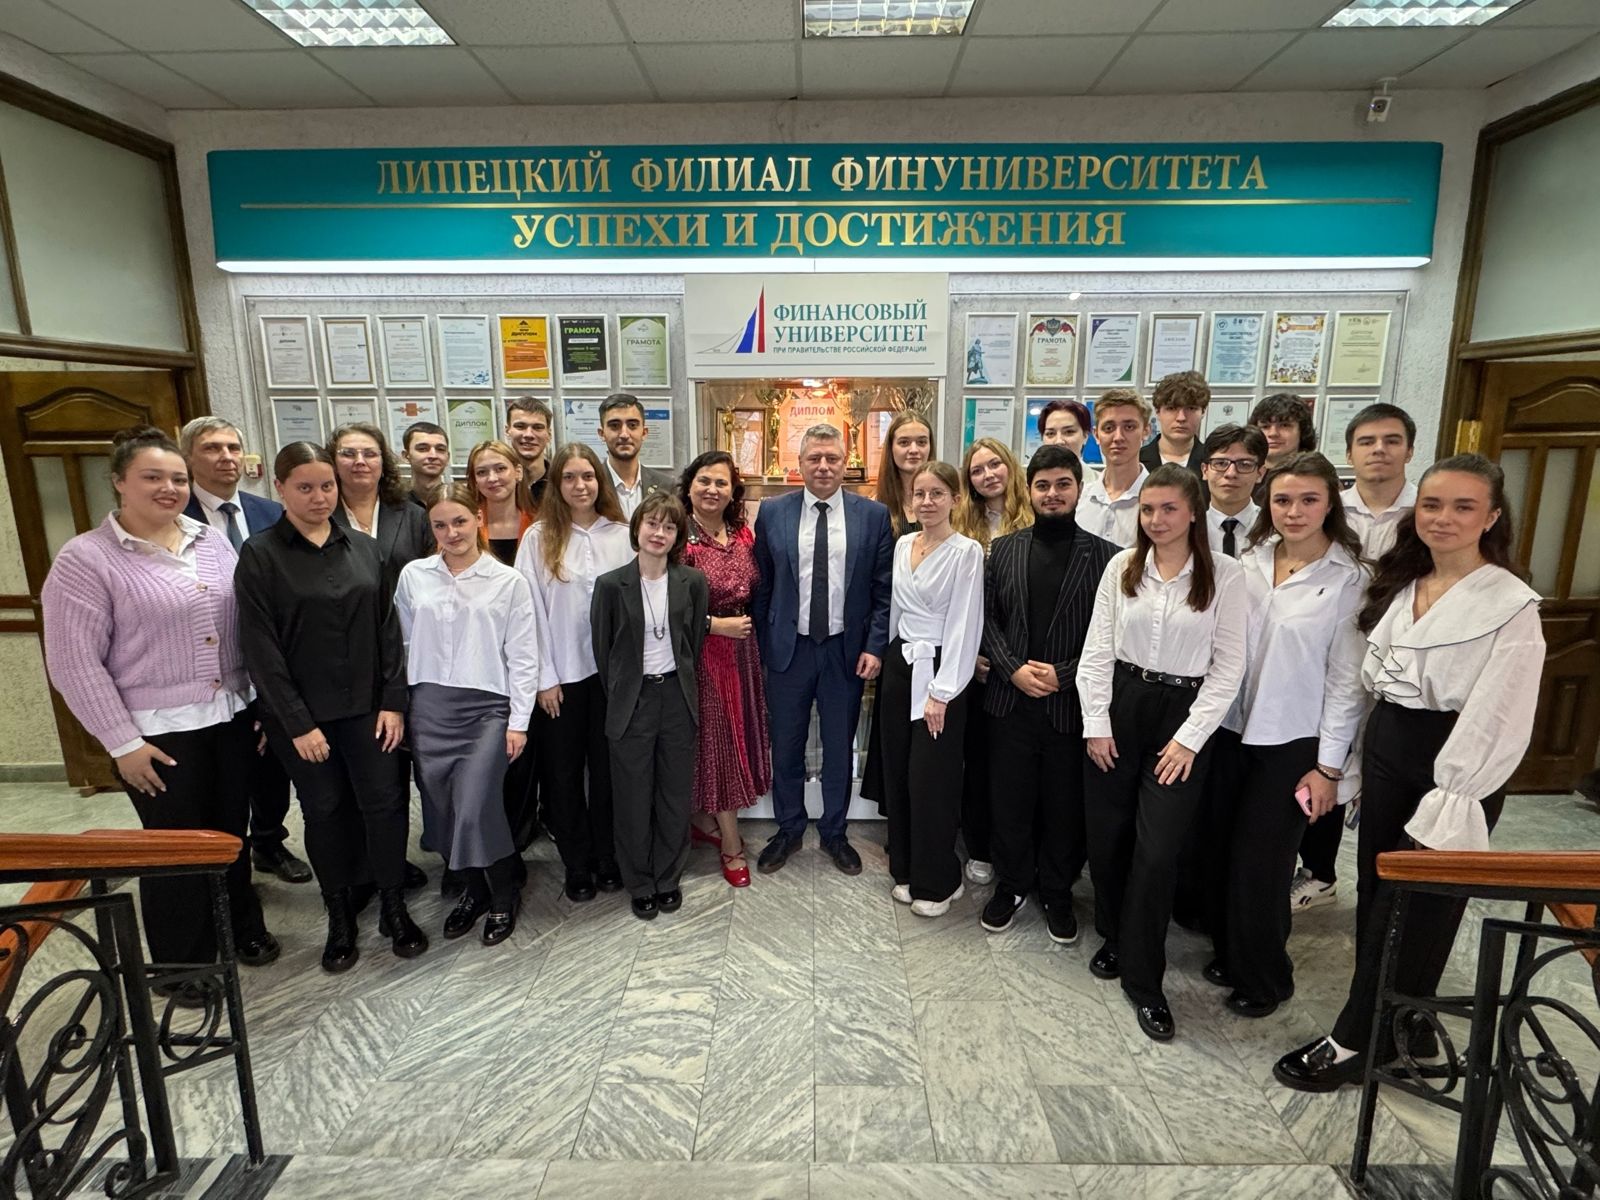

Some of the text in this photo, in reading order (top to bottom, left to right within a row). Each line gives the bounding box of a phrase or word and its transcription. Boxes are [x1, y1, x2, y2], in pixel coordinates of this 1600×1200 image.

[377, 150, 1269, 201] ЛИПЕЦКИЙ ФИЛИАЛ ФИНУНИВЕРСИТЕТА
[512, 211, 1126, 256] УСПЕХИ И ДОСТИЖЕНИЯ
[773, 298, 928, 321] ФИНАНСОВЫЙ
[563, 326, 602, 335] ГРАМОТА
[773, 324, 928, 343] УНИВЕРСИТЕТ
[626, 338, 662, 346] ГРАМОТА
[773, 345, 927, 354] ПРИ ПРАВИТЕЛЬСТВЕ РОССИЙСКОЙ ФЕДЕРАЦИИ
[790, 406, 835, 417] ДИПЛОМ
[455, 420, 488, 428] ДИПЛОМ
